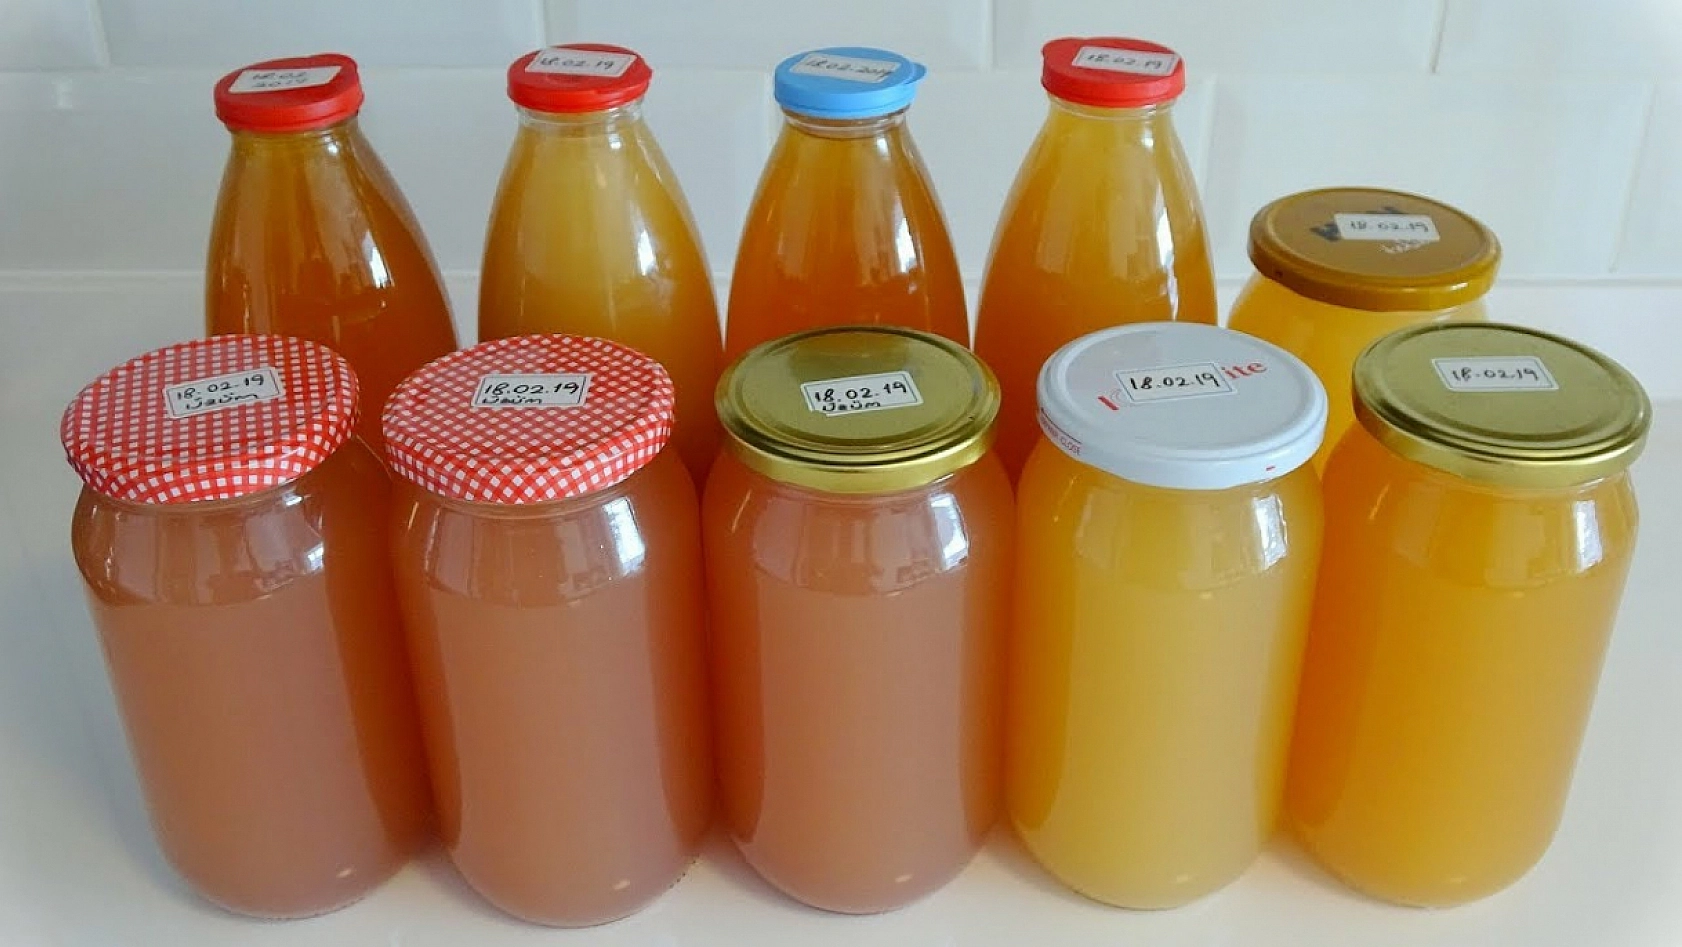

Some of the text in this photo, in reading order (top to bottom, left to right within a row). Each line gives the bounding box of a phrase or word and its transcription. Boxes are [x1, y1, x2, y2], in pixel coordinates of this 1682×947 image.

[177, 373, 264, 400] 18.02.19
[484, 381, 580, 396] 18.02.19
[1129, 372, 1221, 390] 18.02.19
[814, 380, 907, 403] 18.02.19
